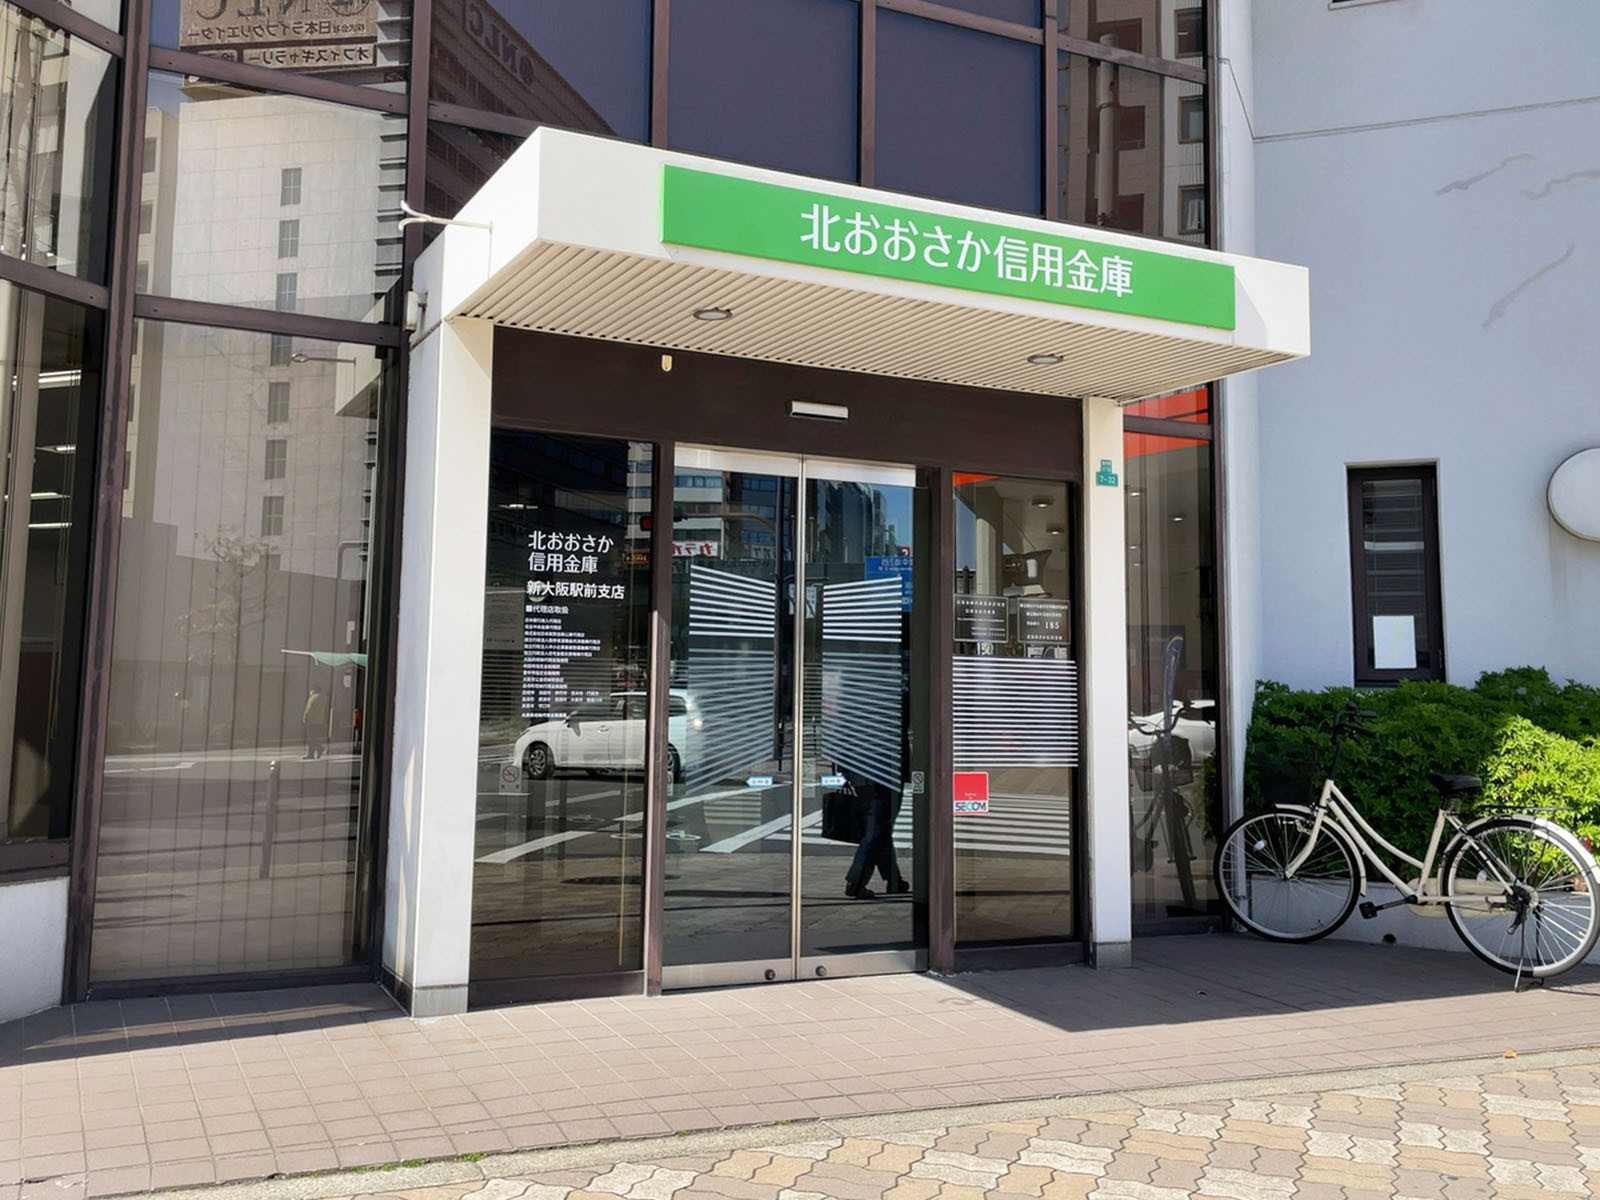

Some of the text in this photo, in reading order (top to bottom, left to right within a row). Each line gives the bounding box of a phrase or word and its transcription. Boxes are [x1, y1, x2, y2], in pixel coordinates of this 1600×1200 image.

[800, 203, 1134, 298] 北おおさか信用金庫
[528, 530, 614, 554] 北おおさか
[528, 552, 599, 574] 信用金庫
[526, 580, 625, 599] 新大阪駅前支店
[1045, 621, 1060, 631] 185
[955, 801, 986, 812] SECOM
